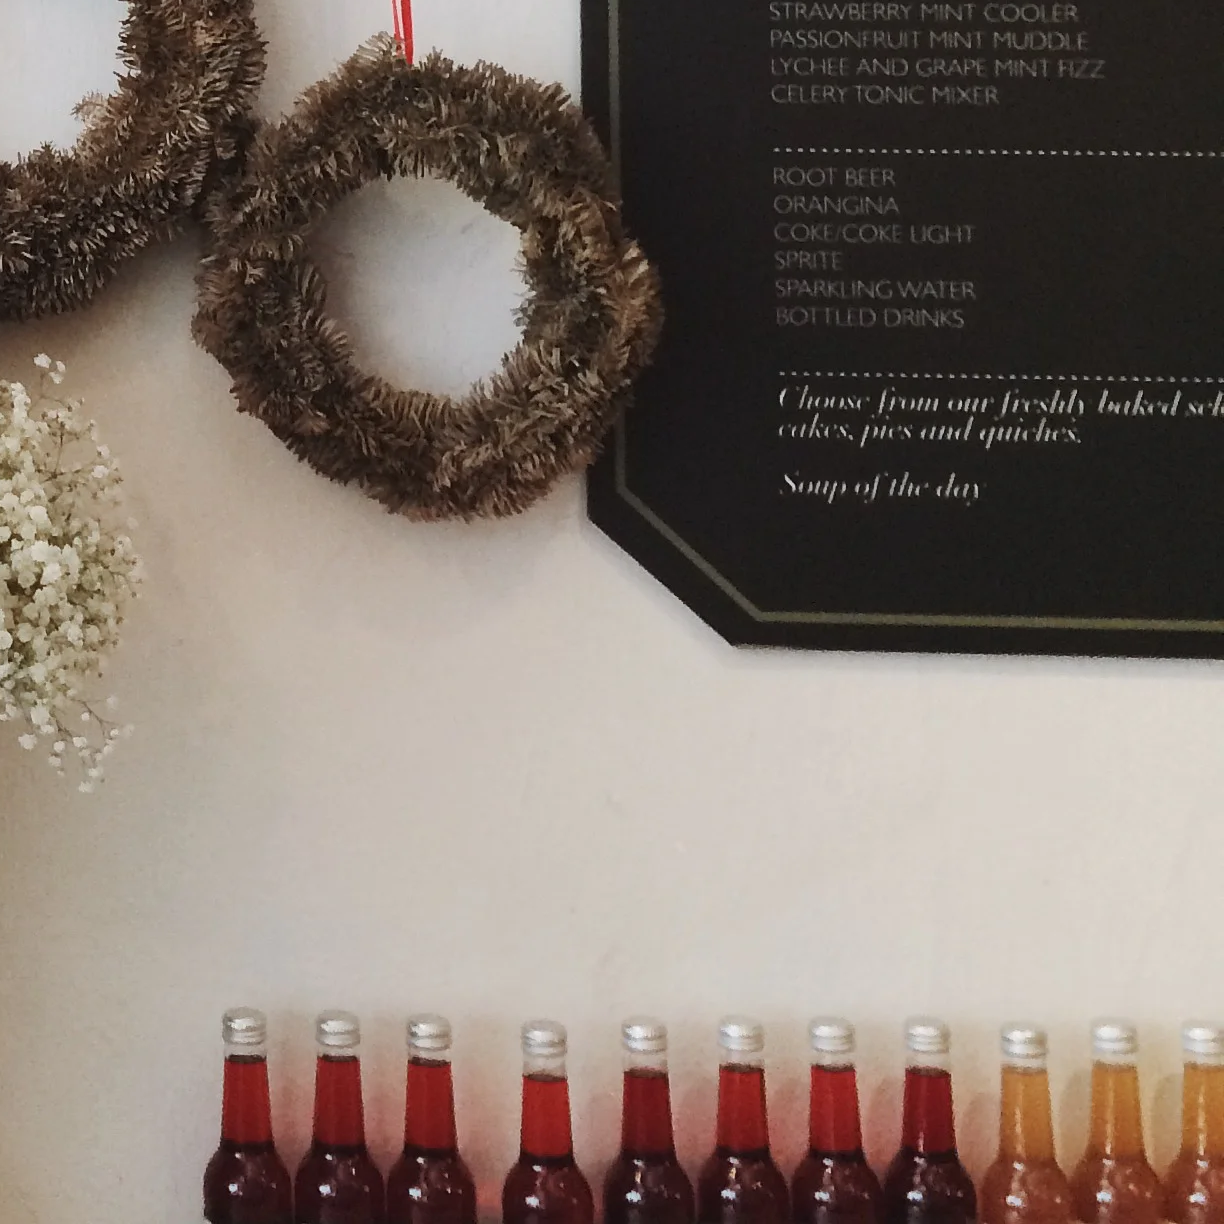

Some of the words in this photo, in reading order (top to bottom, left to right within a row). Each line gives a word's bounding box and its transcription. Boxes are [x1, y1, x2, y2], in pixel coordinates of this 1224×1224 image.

[769, 2, 912, 20] STRAWBERRY
[920, 3, 977, 21] MINT
[983, 3, 1079, 23] COOLER
[769, 30, 921, 49] PASSIONFRUIT
[930, 31, 985, 48] MINT
[993, 32, 1089, 50] MUDDLE
[770, 57, 850, 75] LYCHEE
[856, 58, 909, 76] AND
[915, 59, 987, 77] GRAPE
[994, 59, 1050, 77] MINT
[1058, 59, 1106, 78] FIZZ
[770, 84, 848, 103] CELERY
[853, 85, 925, 104] TONIC
[932, 86, 999, 104] MIXER
[773, 167, 838, 186] ROOT
[844, 168, 896, 186] BEER
[774, 195, 900, 215] ORANGINA
[774, 223, 903, 243] COKE/COKE
[910, 225, 976, 244] LIGHT
[774, 251, 843, 270] SPRITE
[775, 280, 893, 299] SPARKLING
[896, 280, 976, 299] WATER
[776, 307, 877, 327] BOTTLED
[884, 309, 965, 328] DRINKS
[779, 384, 870, 411] Choose
[869, 386, 939, 419] from
[948, 397, 995, 412] our
[994, 388, 1085, 422] freshly
[1097, 389, 1182, 416] baked
[1184, 389, 1224, 417] sel
[860, 416, 913, 448] pies
[919, 416, 974, 441] and
[779, 470, 847, 504] Soup
[854, 472, 889, 505] of
[889, 472, 930, 497] the
[935, 472, 986, 506] day
